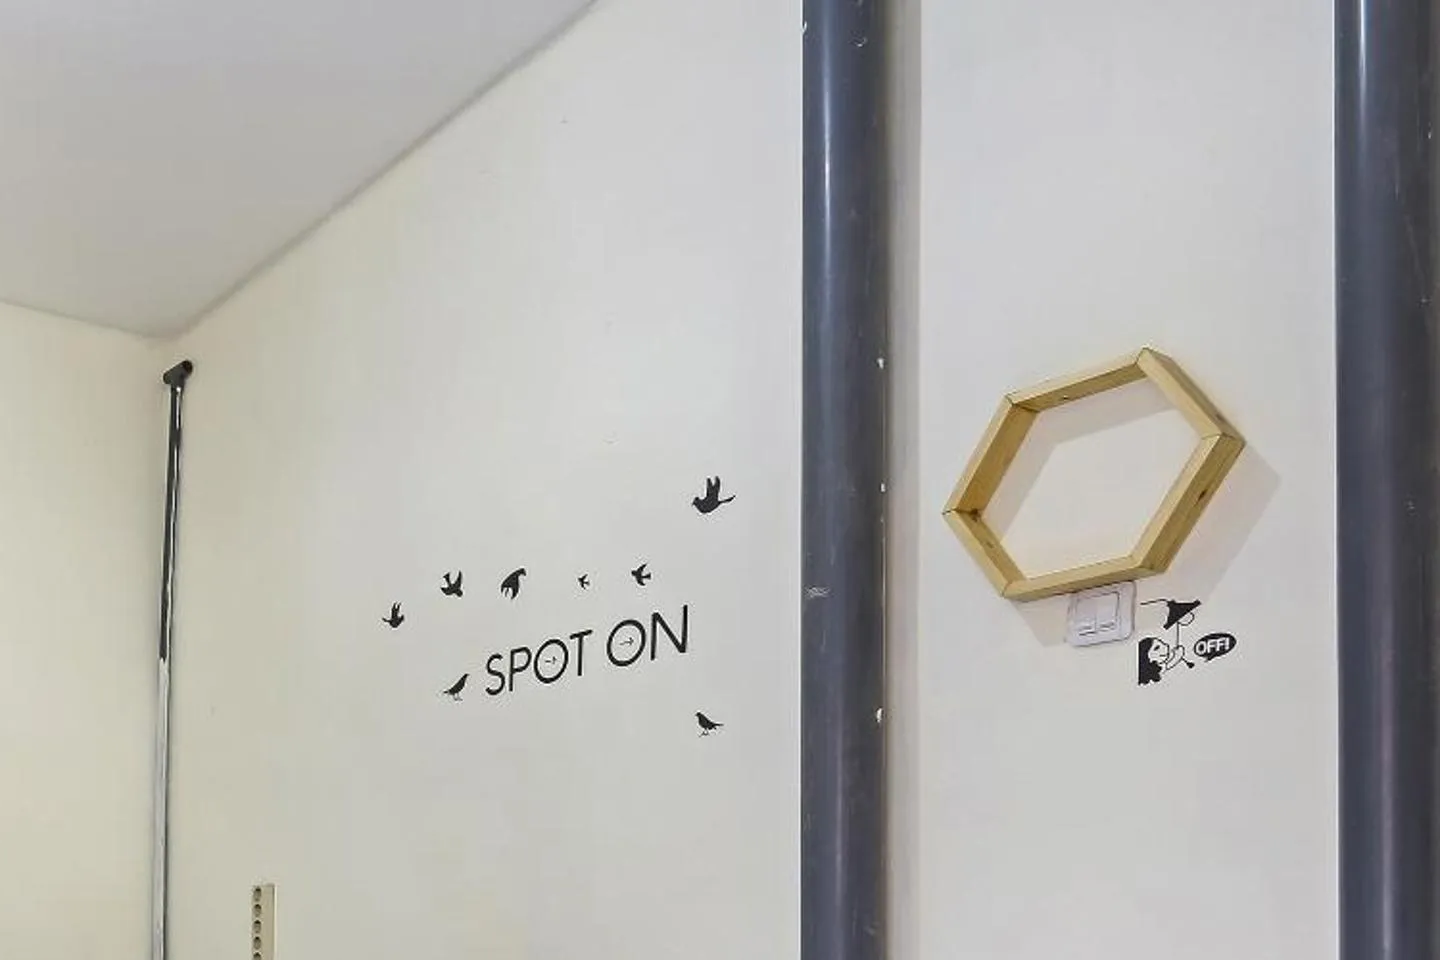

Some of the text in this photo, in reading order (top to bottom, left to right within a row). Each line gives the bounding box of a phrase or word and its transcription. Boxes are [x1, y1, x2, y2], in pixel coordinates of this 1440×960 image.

[485, 604, 688, 695] SPOT ON
[1195, 637, 1230, 655] OFF!
